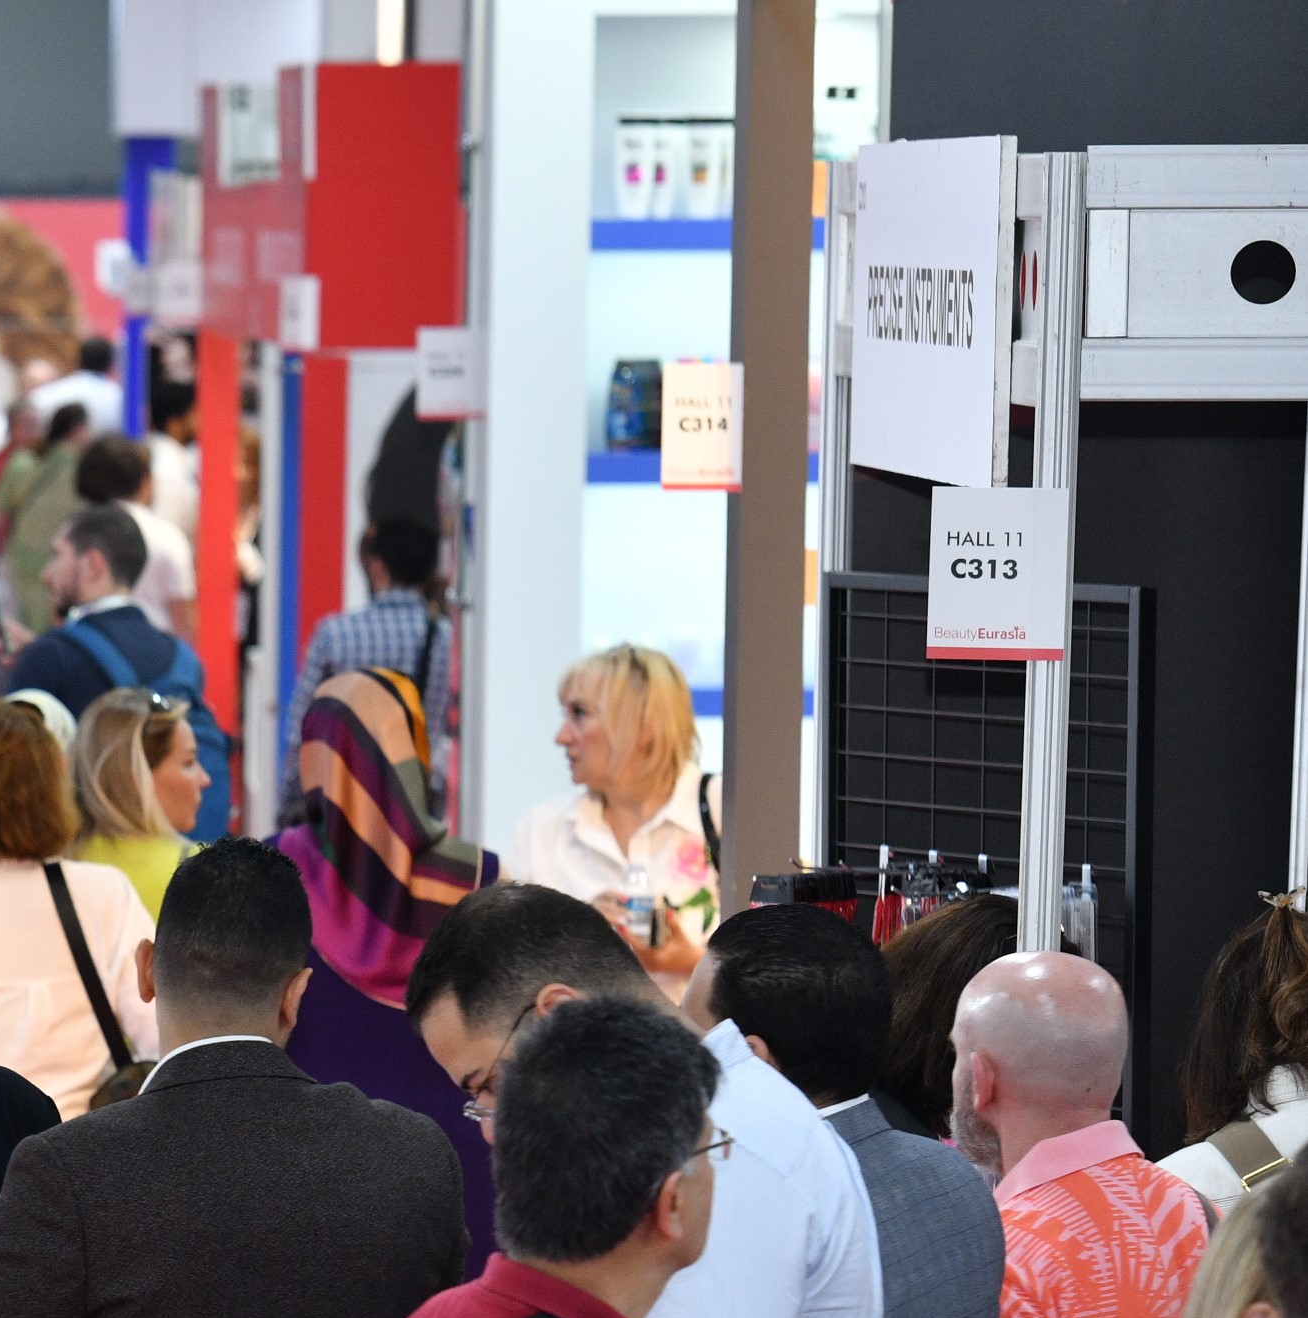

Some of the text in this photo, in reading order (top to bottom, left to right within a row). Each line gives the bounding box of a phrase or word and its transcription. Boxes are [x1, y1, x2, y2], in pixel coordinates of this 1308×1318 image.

[867, 266, 974, 349] PRECISE INSTRUMENTS
[679, 417, 727, 433] C314
[947, 531, 1022, 547] HALL 11
[950, 558, 1018, 580] C313
[934, 625, 1026, 641] BeautyEurasia
